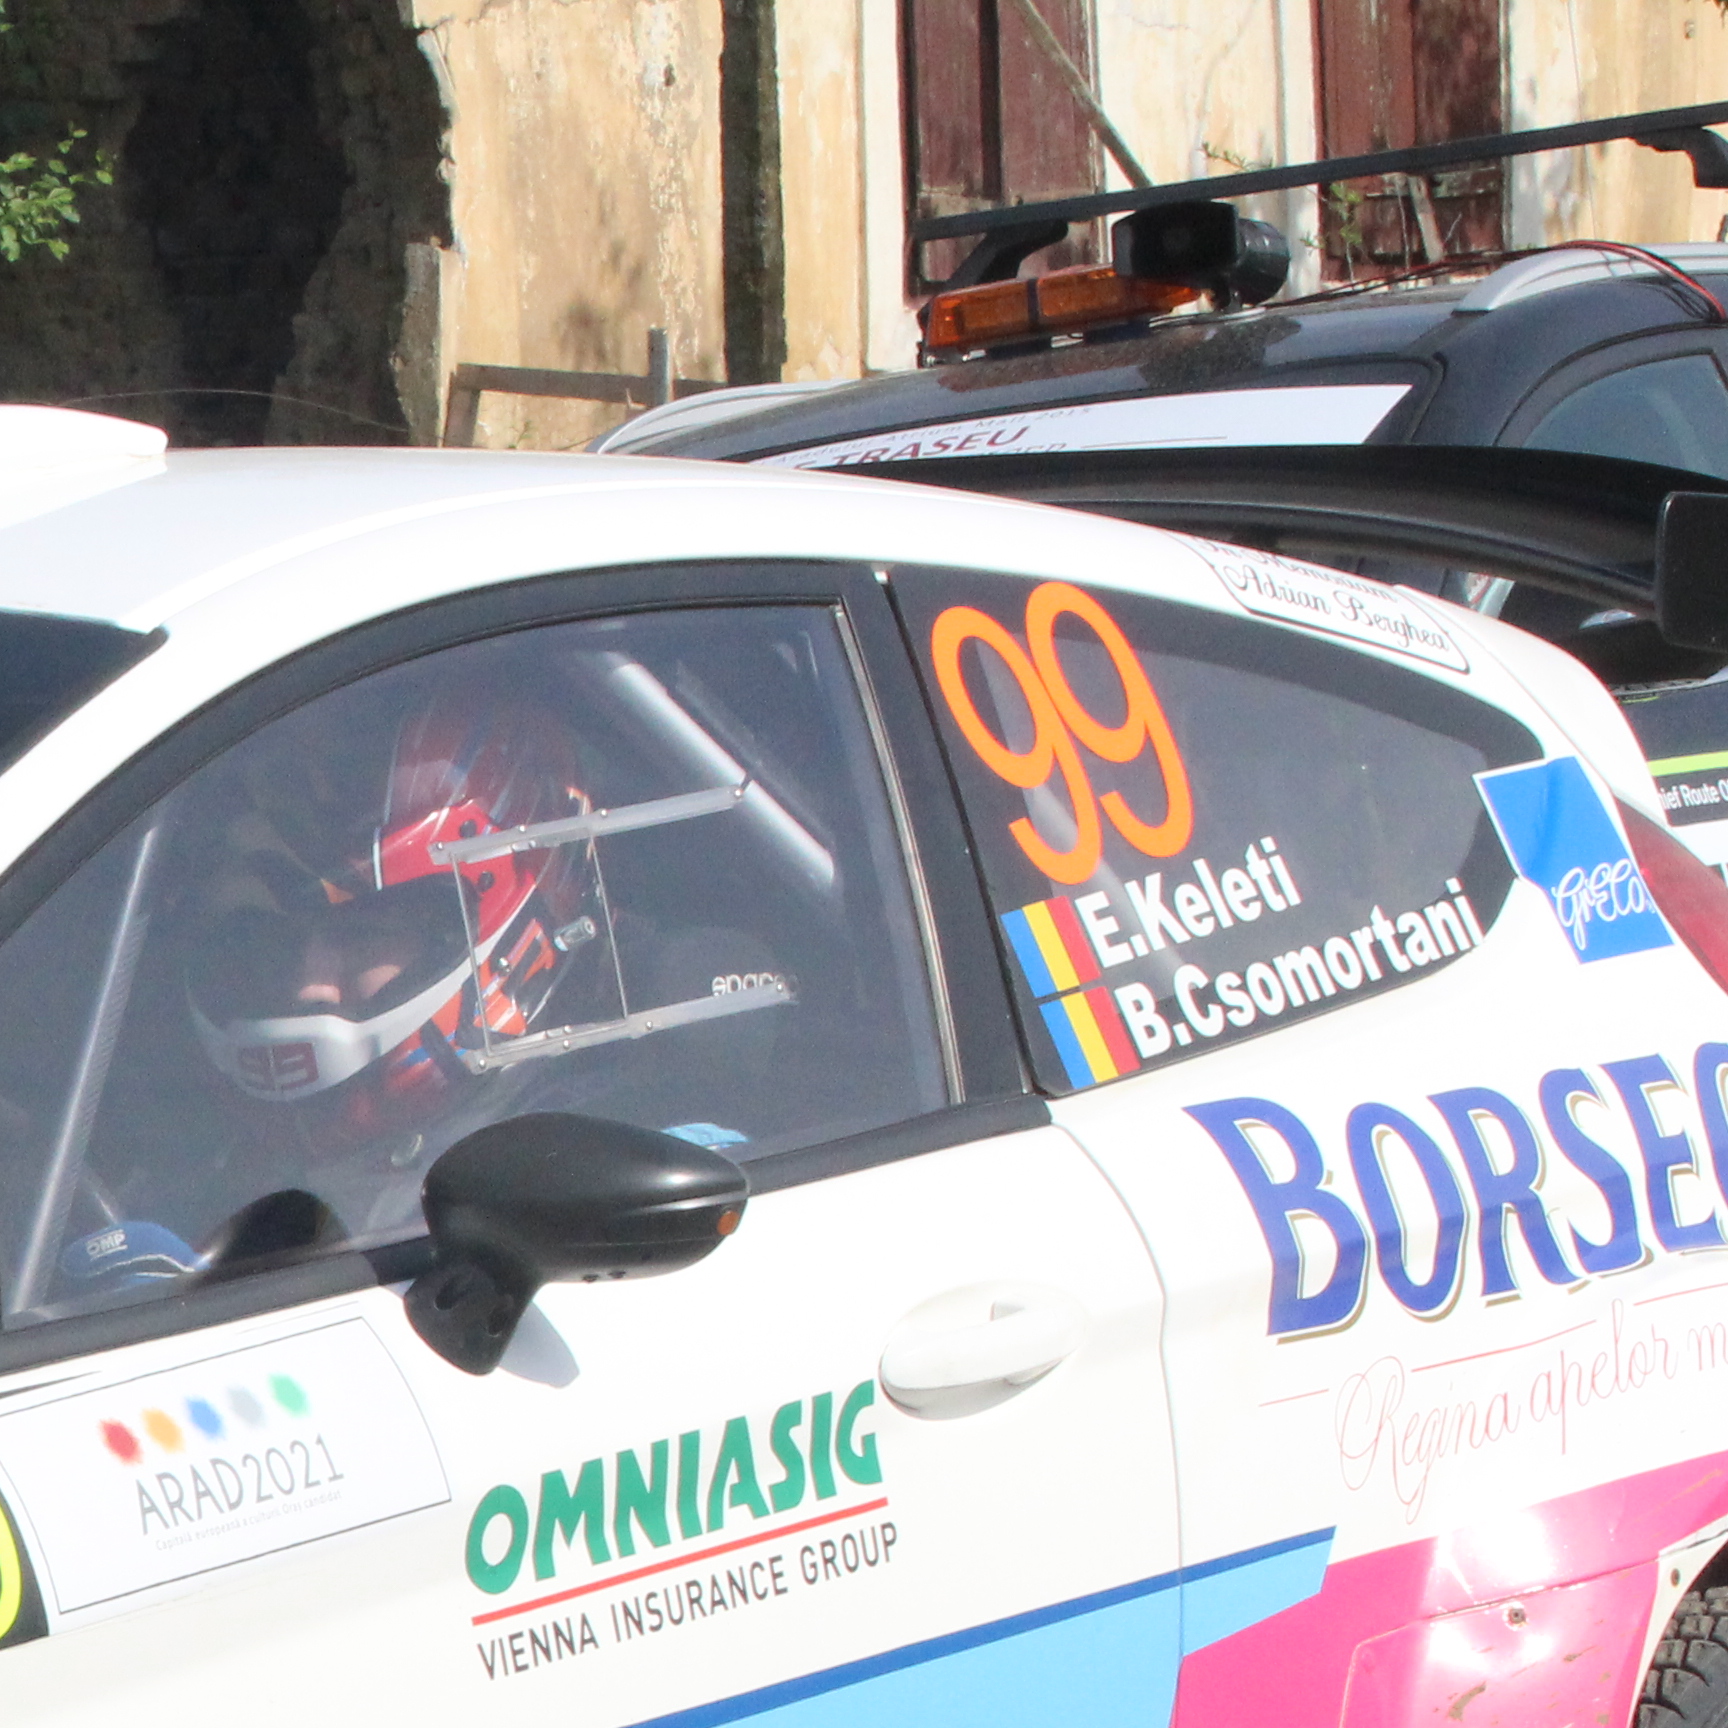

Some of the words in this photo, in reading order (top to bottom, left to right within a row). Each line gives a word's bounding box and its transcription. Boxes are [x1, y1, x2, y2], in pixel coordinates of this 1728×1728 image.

[1222, 564, 1332, 616] Adrian
[1333, 586, 1452, 651] Berghea
[931, 580, 1195, 886] 99
[1679, 780, 1720, 808] Route
[1073, 836, 1302, 969] E.Keleti
[1113, 877, 1487, 1059] B.Csomortani
[135, 1432, 346, 1535] ARAD2021
[303, 1488, 344, 1510] candidat
[464, 1378, 884, 1596] OMNIASIG
[477, 1612, 600, 1681] VIENNA
[610, 1554, 790, 1643] INSURANCE
[799, 1521, 899, 1586] GROUP
